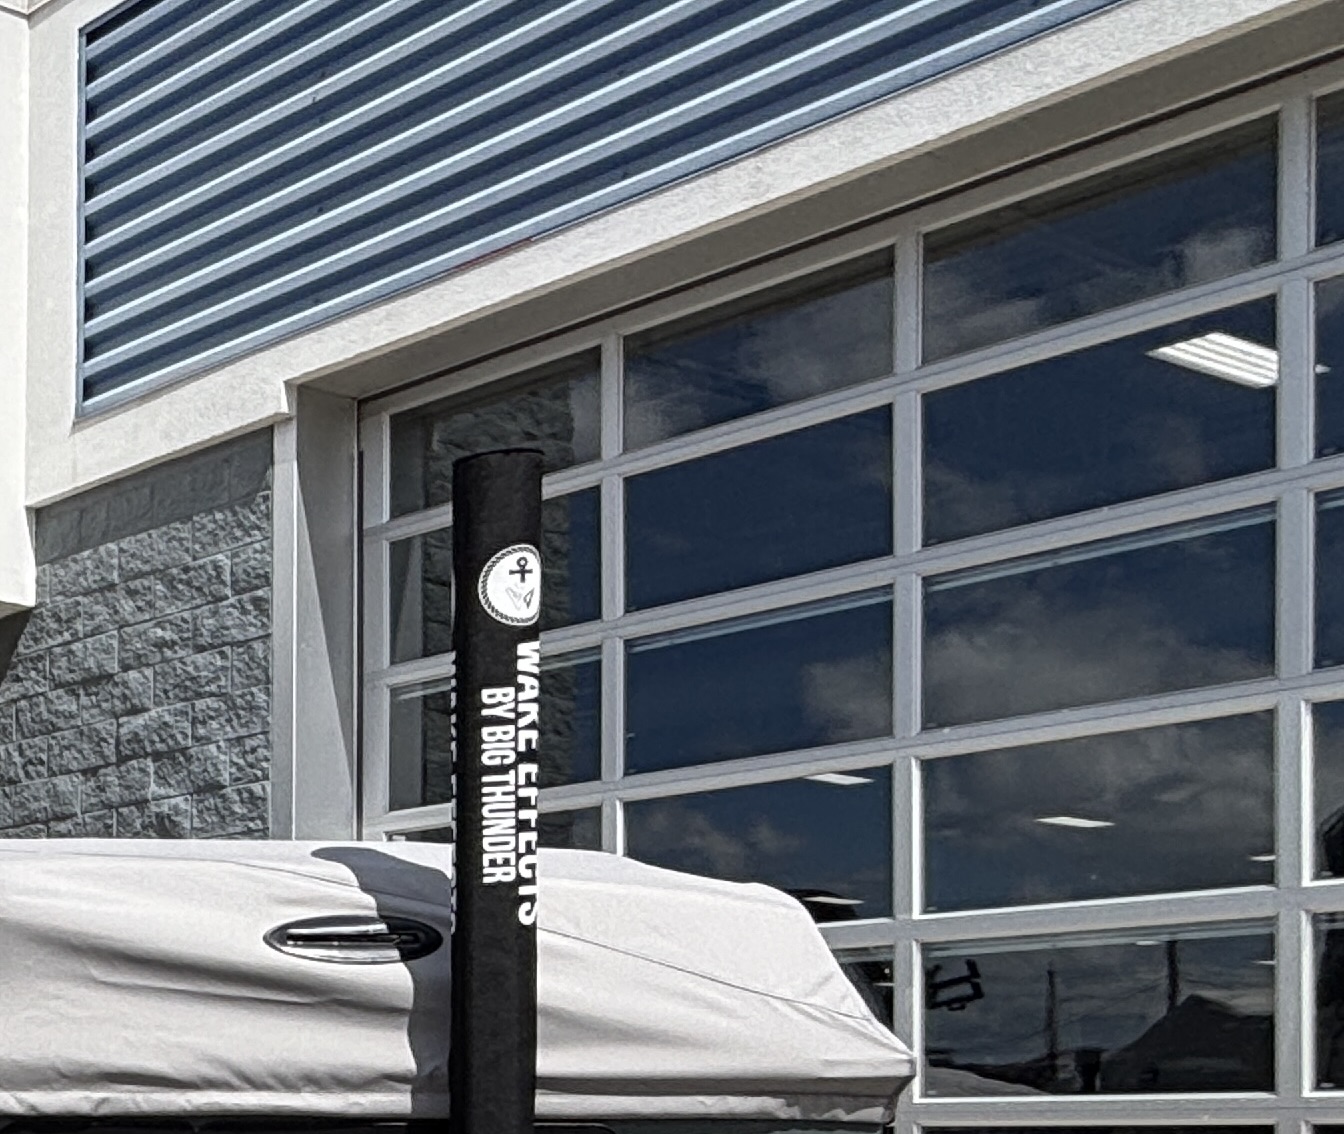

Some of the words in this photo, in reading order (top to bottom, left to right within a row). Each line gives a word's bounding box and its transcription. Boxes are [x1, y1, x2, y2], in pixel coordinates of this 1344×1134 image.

[480, 686, 516, 720] BY
[480, 725, 517, 766] BIG
[516, 640, 540, 753] WAKE
[480, 769, 517, 884] THUNDER
[516, 763, 539, 926] EFFECTS
